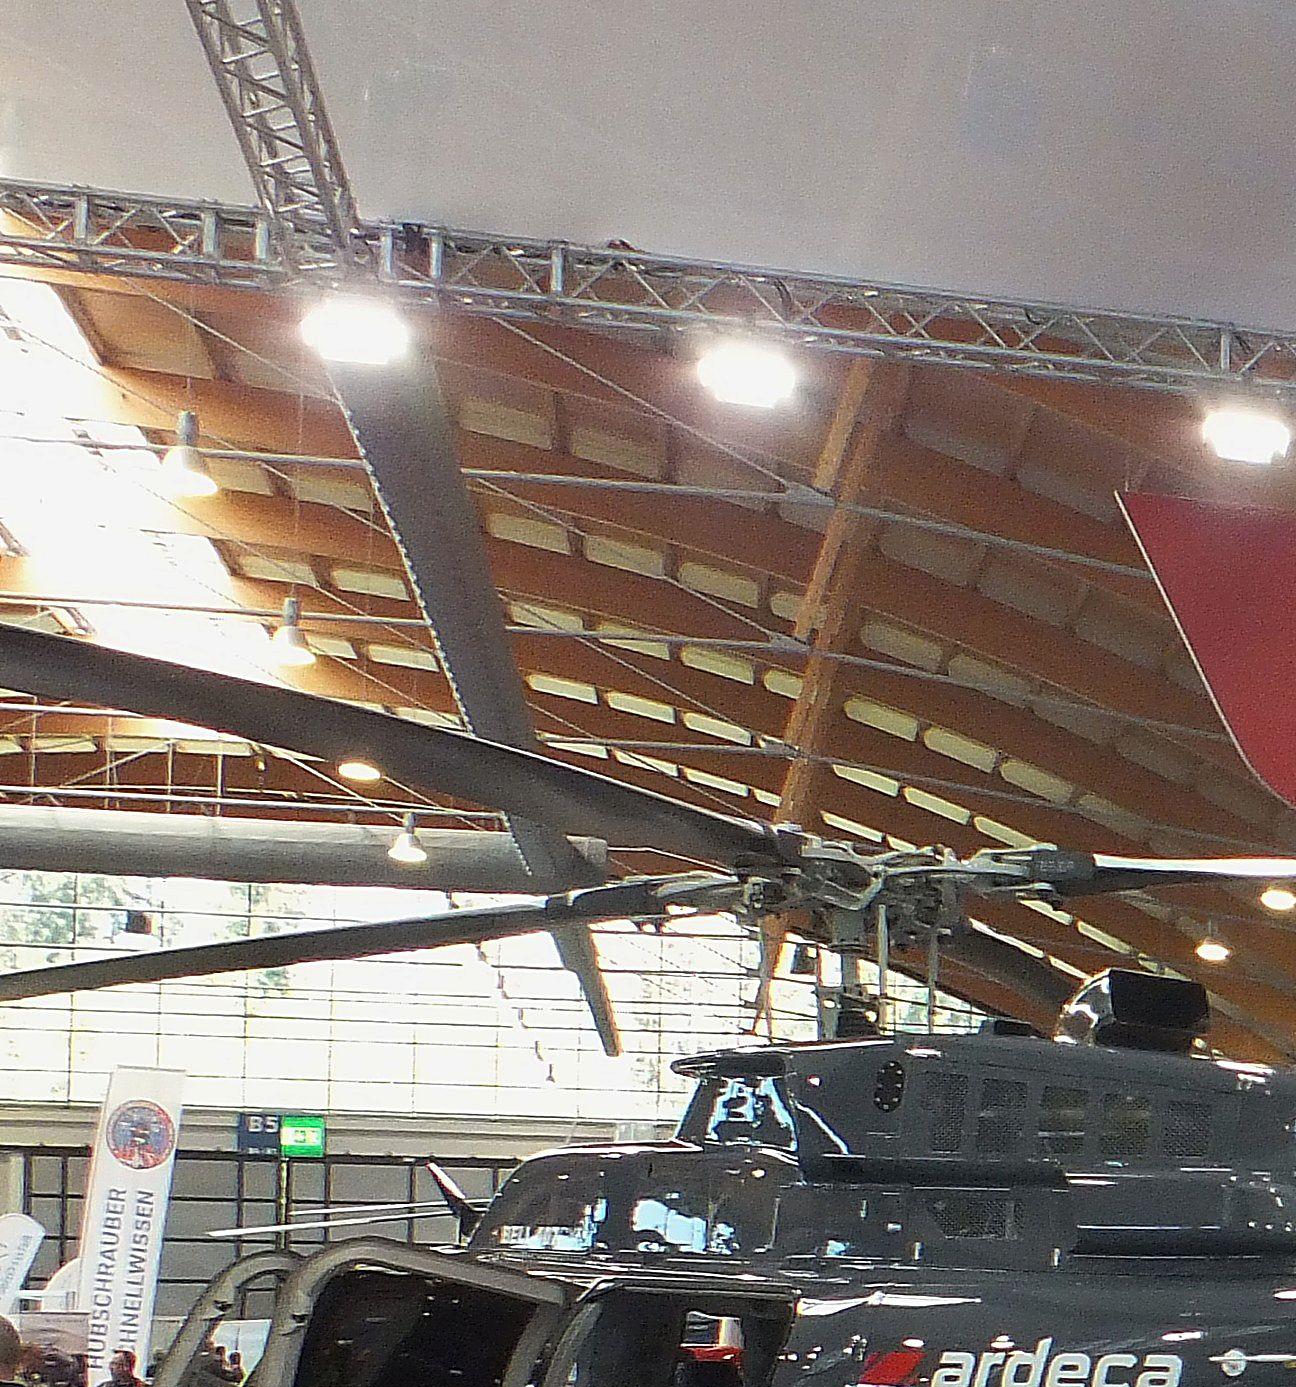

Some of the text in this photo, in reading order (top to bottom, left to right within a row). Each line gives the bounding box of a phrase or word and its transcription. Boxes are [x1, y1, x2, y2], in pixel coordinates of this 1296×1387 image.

[248, 1116, 280, 1133] B5
[90, 1188, 127, 1370] HUBSCHRAUBER
[119, 1190, 155, 1350] HNELLWISSEN
